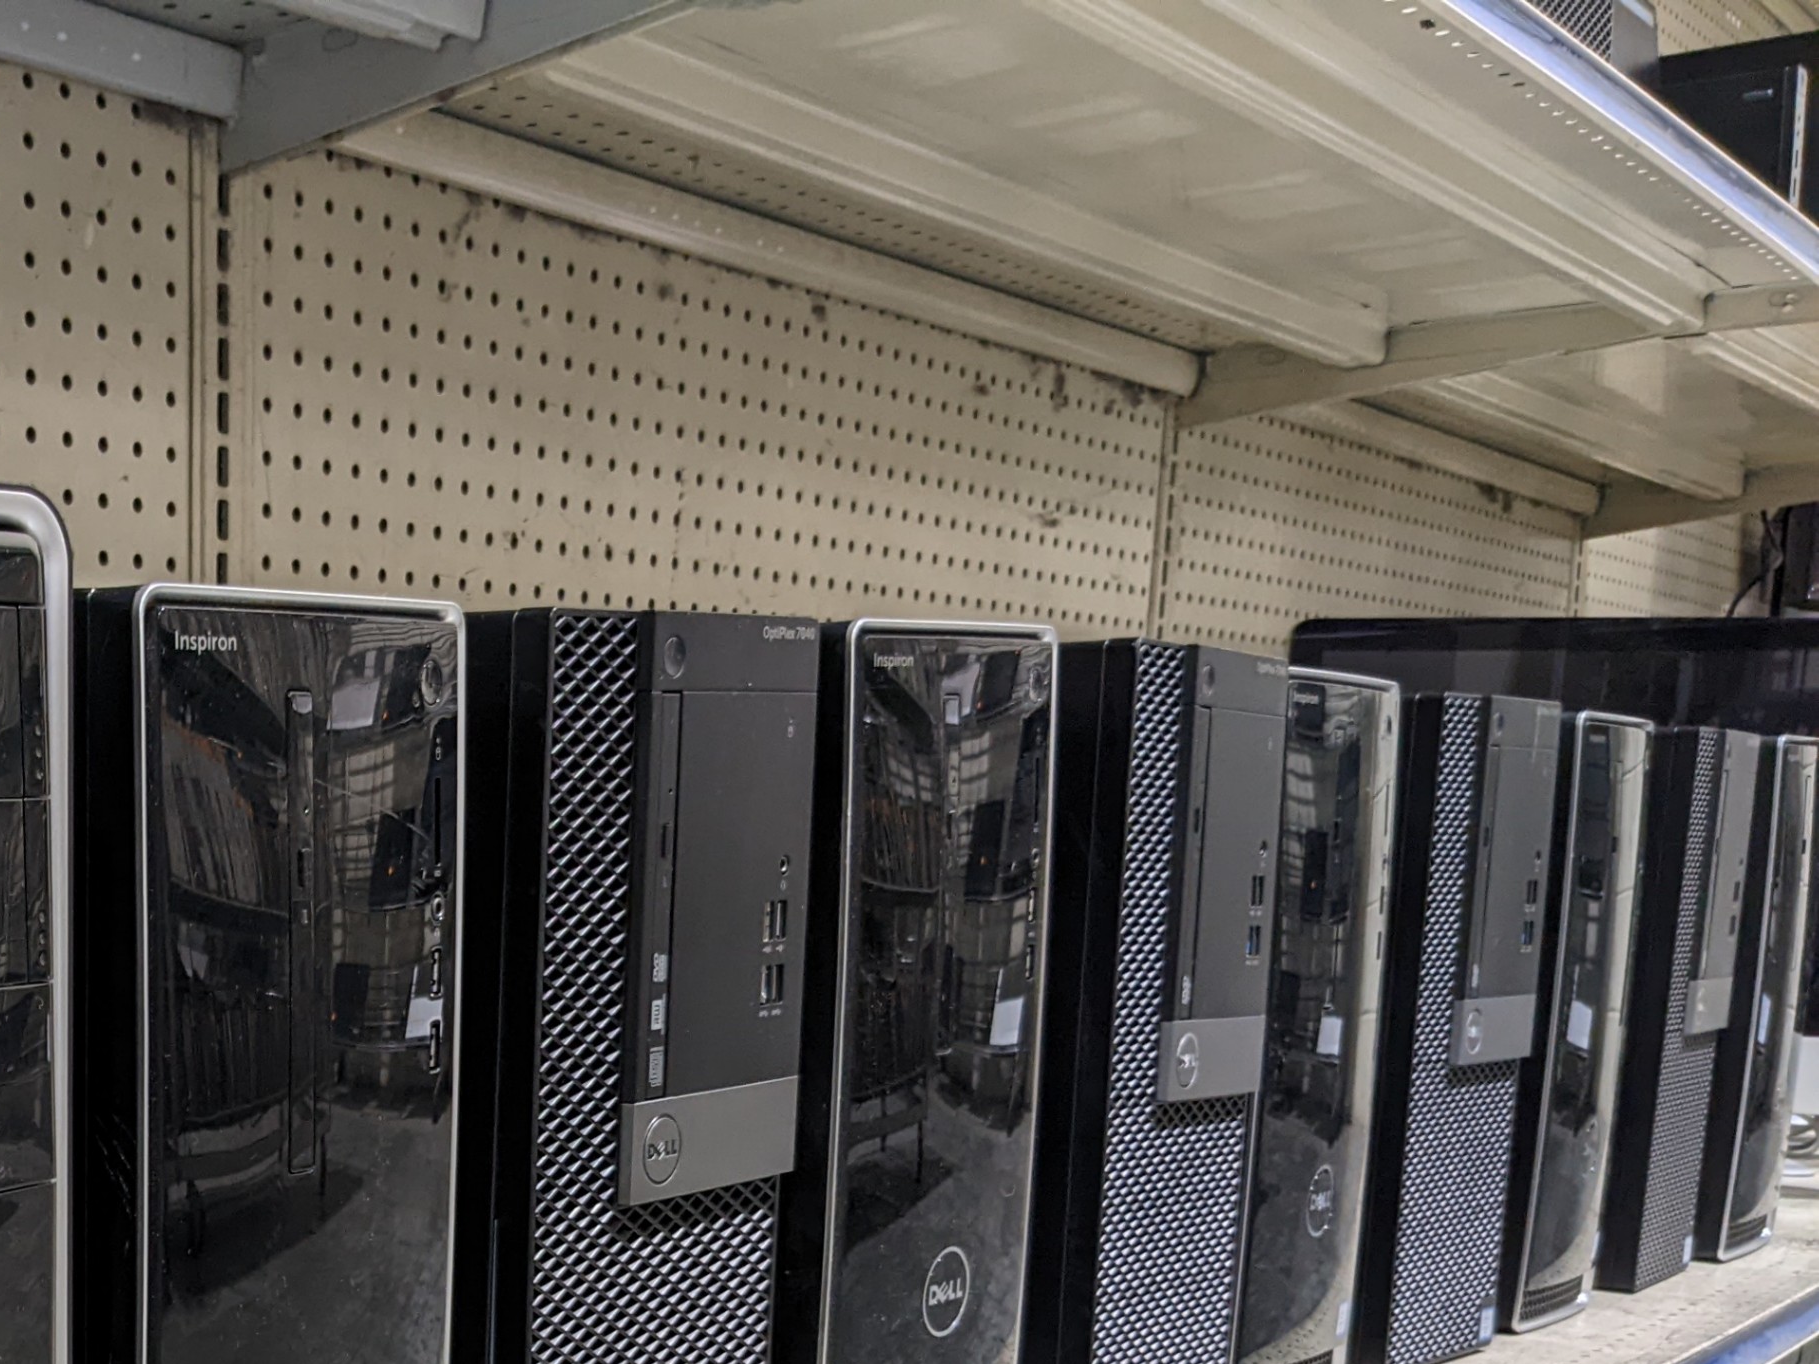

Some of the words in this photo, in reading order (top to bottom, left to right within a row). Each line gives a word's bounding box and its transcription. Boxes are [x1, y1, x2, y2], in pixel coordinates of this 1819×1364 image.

[174, 630, 238, 656] Inspiron
[763, 625, 795, 642] OptiPlex
[873, 652, 915, 670] Inspiron
[646, 1139, 678, 1161] DELL
[928, 1277, 964, 1307] DELL
